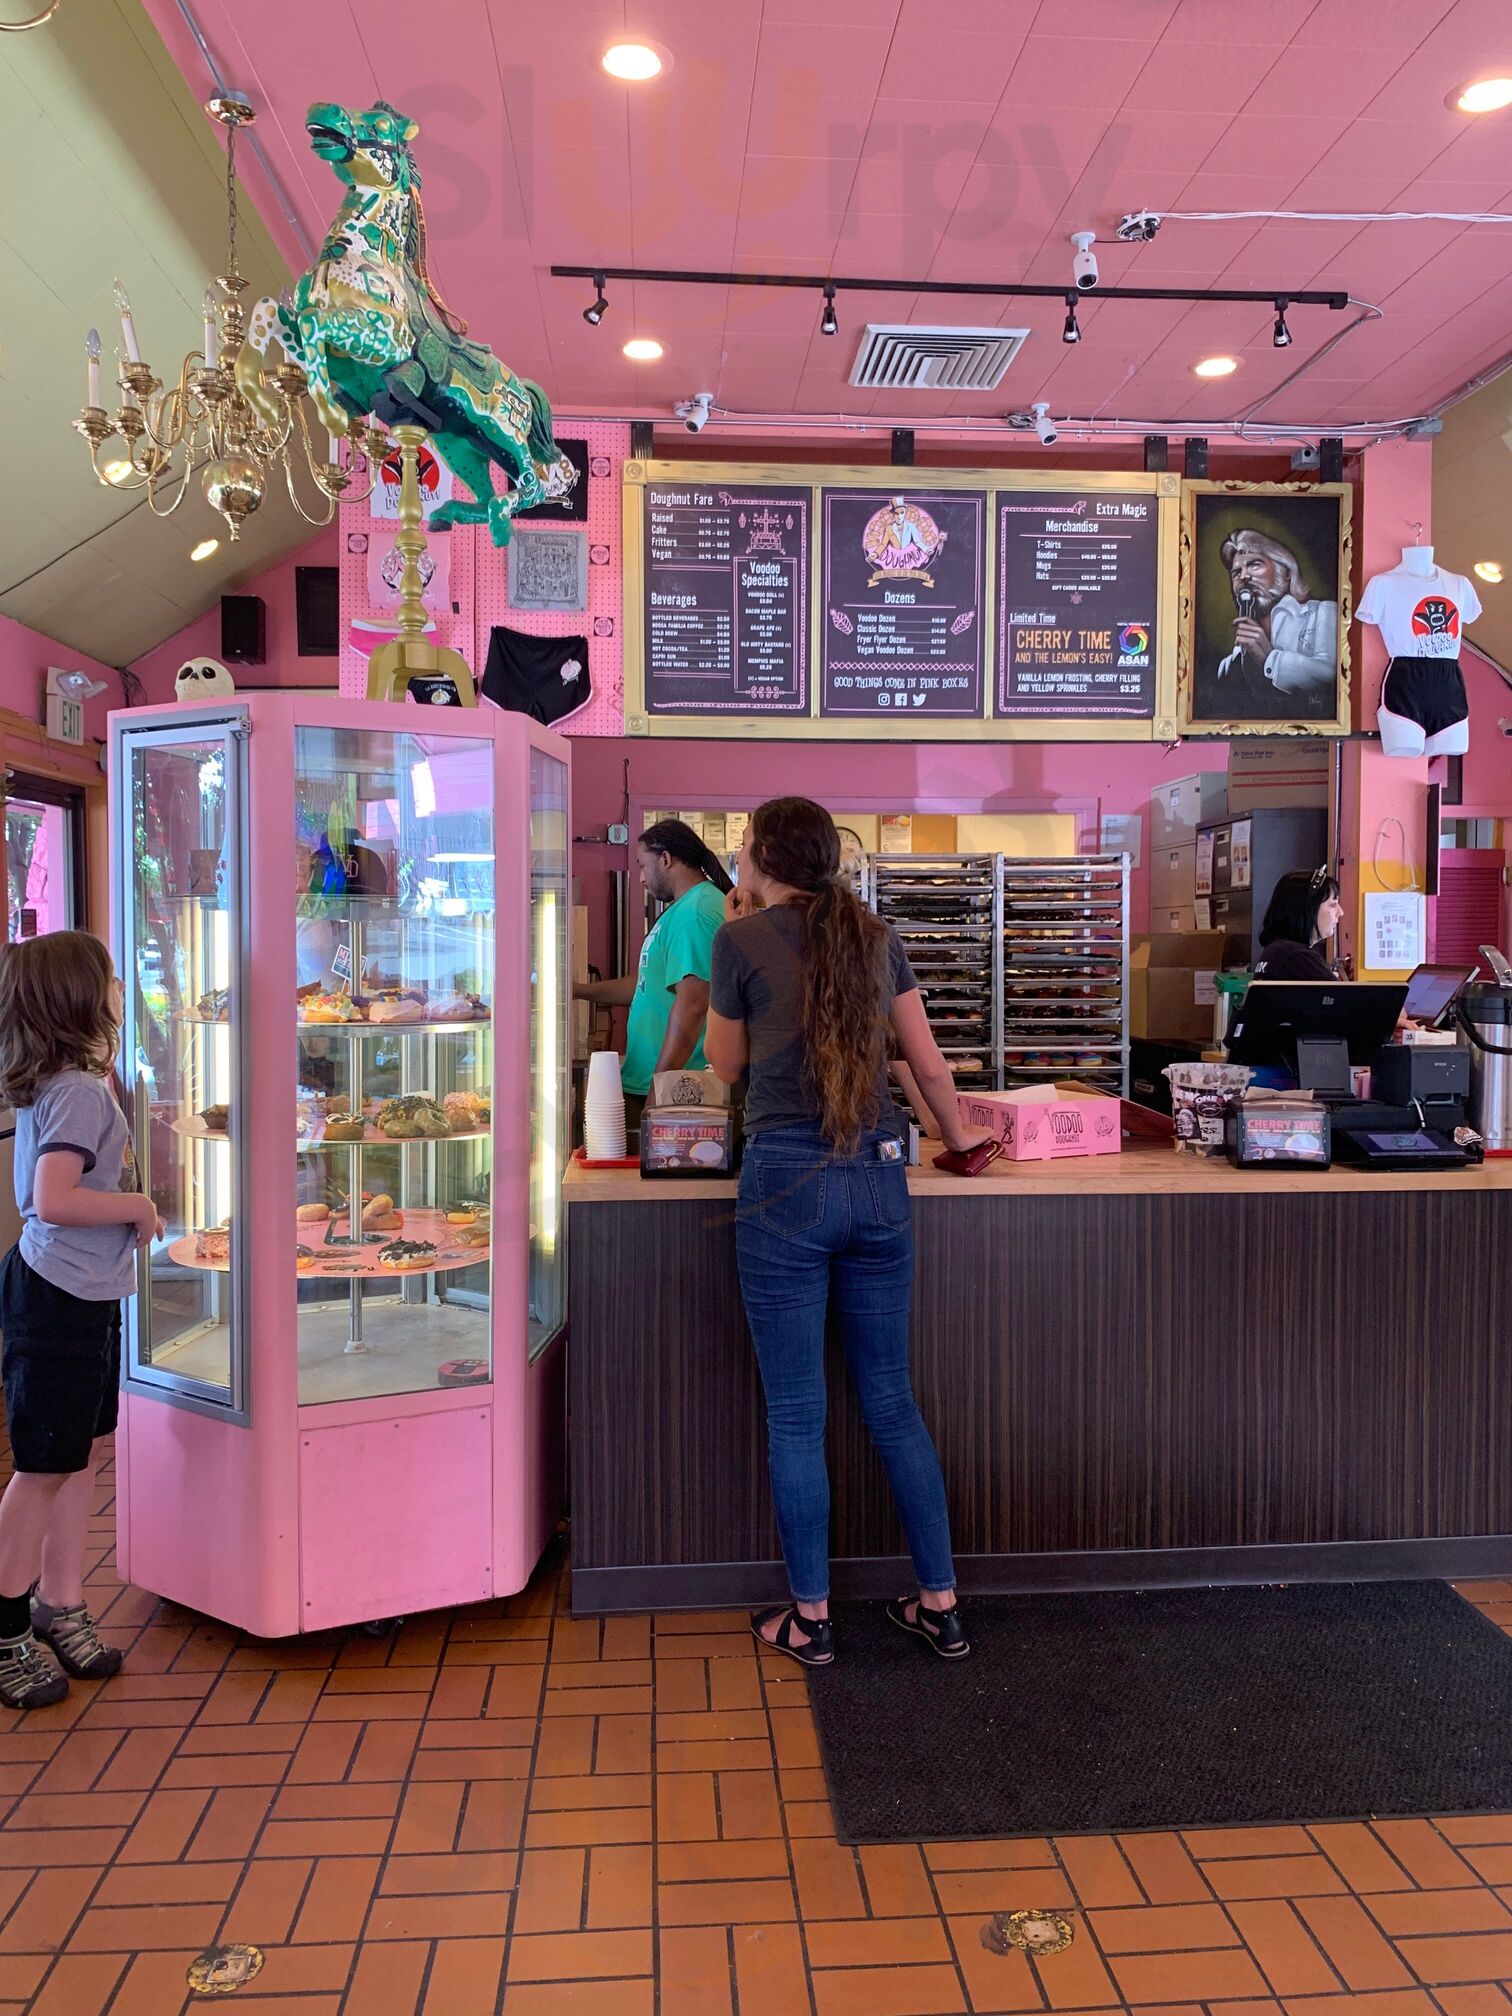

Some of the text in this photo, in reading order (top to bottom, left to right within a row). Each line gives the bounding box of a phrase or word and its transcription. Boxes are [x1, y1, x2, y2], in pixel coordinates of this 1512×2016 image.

[651, 492, 713, 507] Doughnut Fare
[1096, 503, 1147, 518] Extra Magic
[652, 513, 673, 522] Raised
[652, 525, 667, 535] Cake
[1046, 520, 1098, 532] Merchandise
[652, 537, 678, 547] Fritters
[1037, 540, 1061, 549] T-Shirts
[652, 549, 672, 560] Vegan
[1036, 551, 1057, 559] Hoodies
[750, 560, 781, 574] Voodoo
[1036, 561, 1051, 571] Mugs
[742, 573, 789, 588] Specialties
[1036, 572, 1049, 580] Hats
[651, 592, 697, 608] Beverages
[884, 591, 915, 604] Dozens
[858, 614, 877, 622] Voodoo
[878, 614, 896, 622] Dozen
[1010, 613, 1056, 623] Limited Time
[857, 625, 877, 633] Classic
[878, 625, 895, 633] Dozen
[857, 635, 872, 645] Fryer
[874, 635, 888, 645] Flyer
[889, 635, 906, 644] Dozen
[1016, 630, 1112, 650] CHERRY TIME
[857, 645, 874, 655] Vegan
[876, 646, 895, 654] Voodoo
[896, 646, 914, 654] Dozen
[1015, 652, 1113, 664] AND THE LEMON'S EASY!
[1117, 655, 1149, 665] ASAN
[834, 676, 969, 688] GOOD THINGS COME IN PINK BOXES
[1017, 673, 1141, 683] VANILLA LEMON FROSTING, CHERRY FILLING
[1017, 684, 1140, 693] AND YELLOW SPRINKLES $3.25
[63, 699, 80, 740] EXIT
[1045, 1110, 1084, 1134] VOODOO
[1247, 1119, 1320, 1130] CHERRY TIME
[652, 1127, 725, 1137] CHERRY TIME
